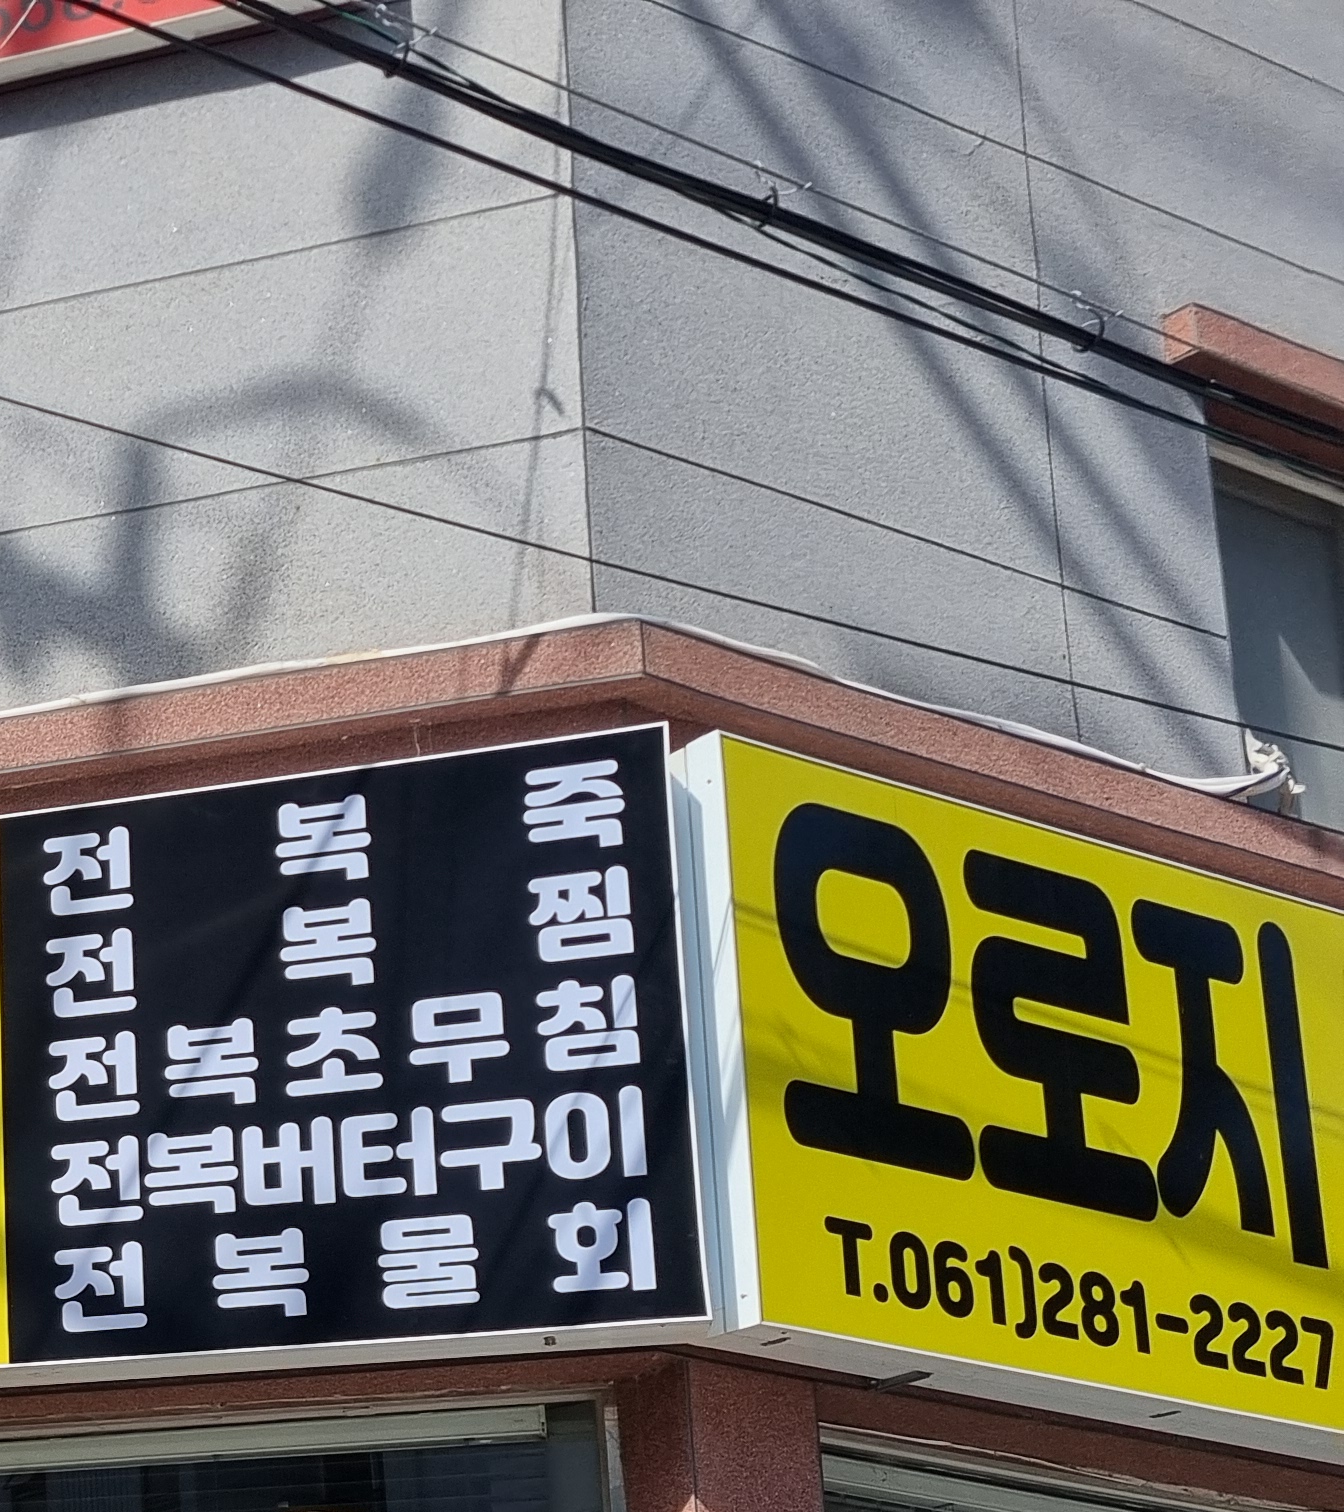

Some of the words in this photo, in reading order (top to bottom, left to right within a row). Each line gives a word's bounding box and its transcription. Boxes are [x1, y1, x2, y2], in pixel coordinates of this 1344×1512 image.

[773, 801, 1330, 1269] 오로지
[50, 1085, 648, 1227] 전복버터구이
[824, 1215, 1334, 1390] T.061)281-2227
